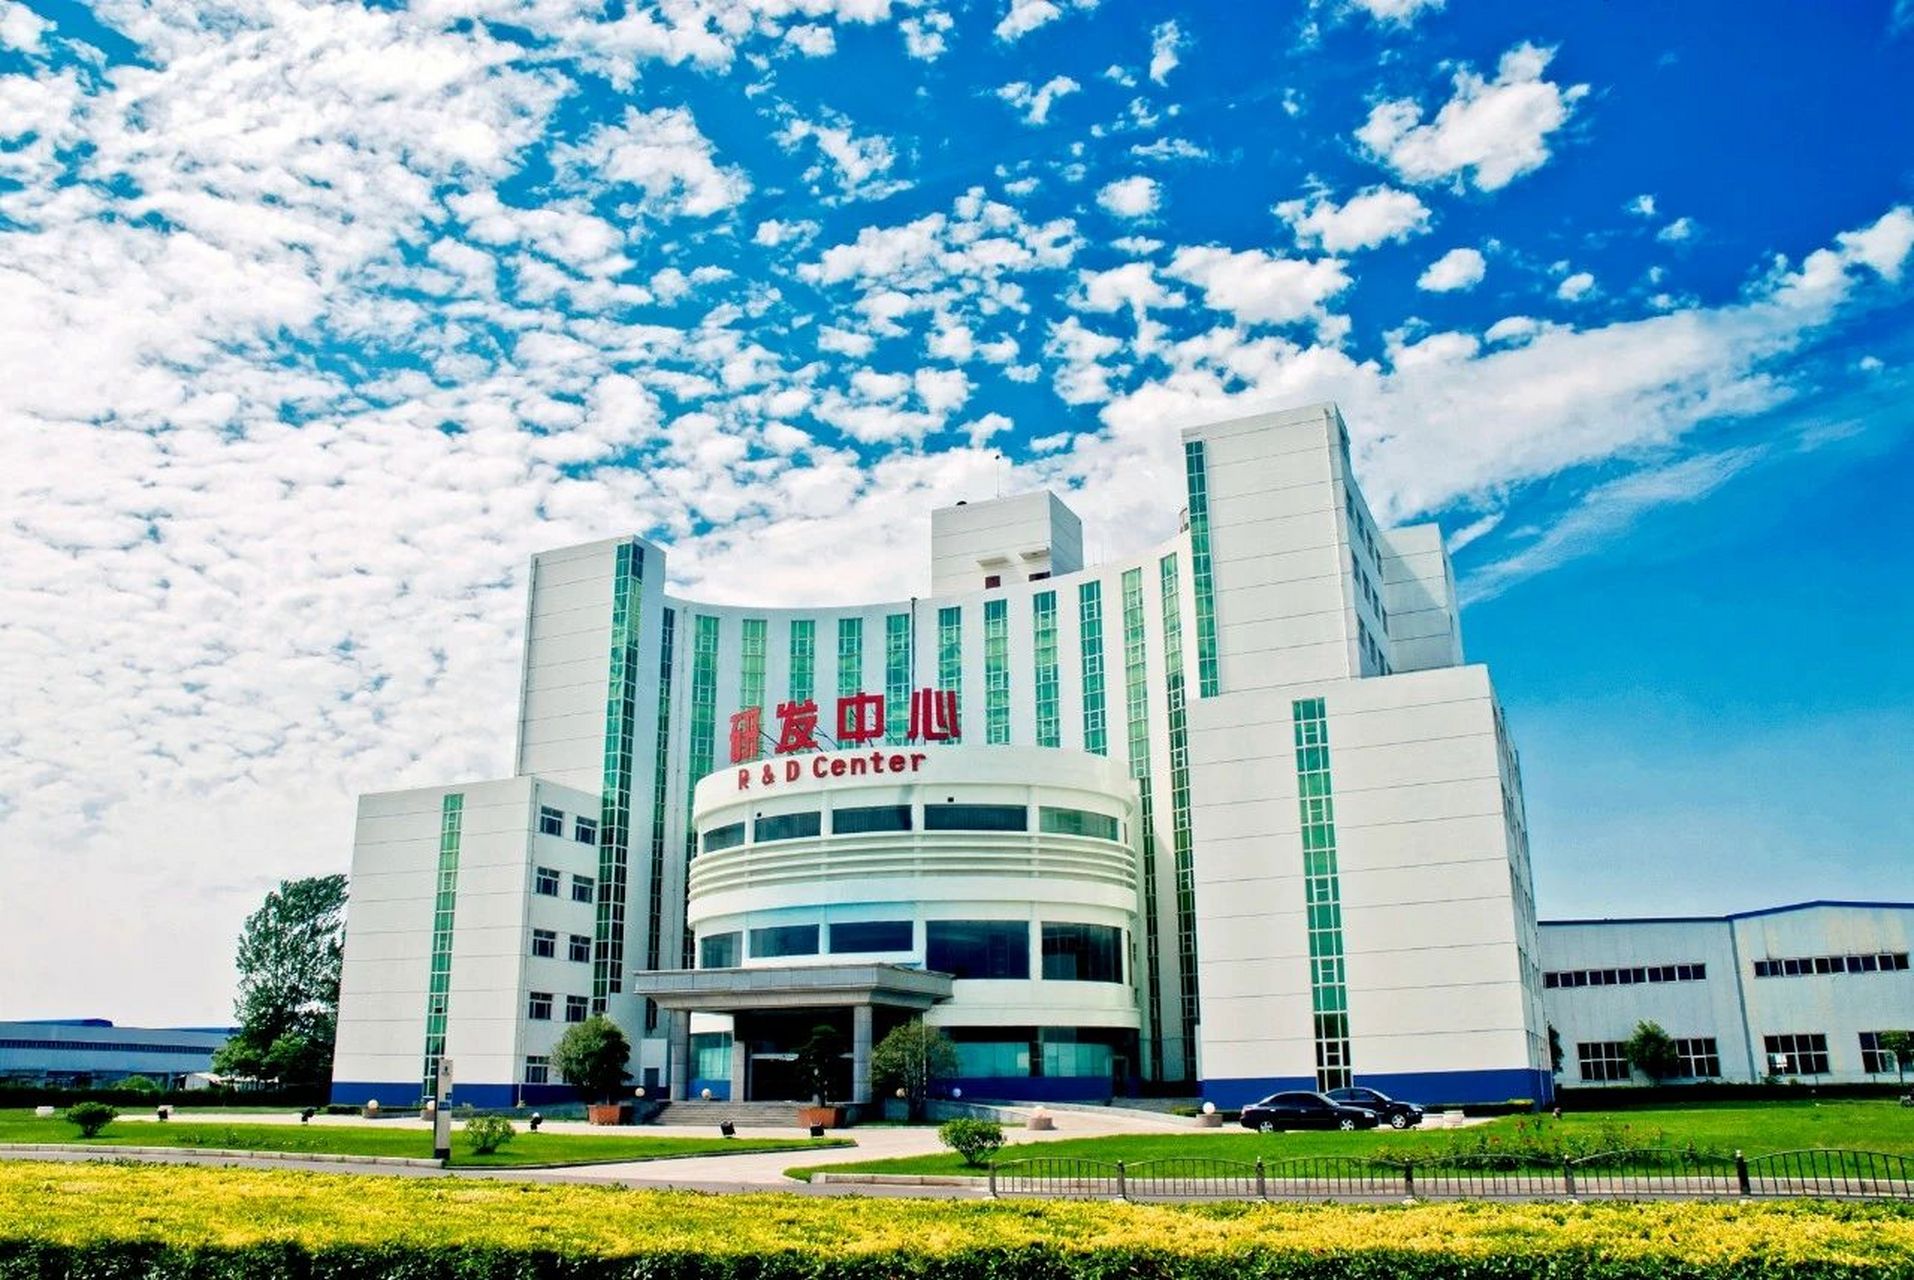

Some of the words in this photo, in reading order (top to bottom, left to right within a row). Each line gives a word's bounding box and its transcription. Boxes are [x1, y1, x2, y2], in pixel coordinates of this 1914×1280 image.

[729, 687, 962, 764] 研发中心
[738, 768, 750, 790] R
[761, 763, 776, 786] &
[786, 759, 800, 783] D
[812, 750, 926, 779] Center
